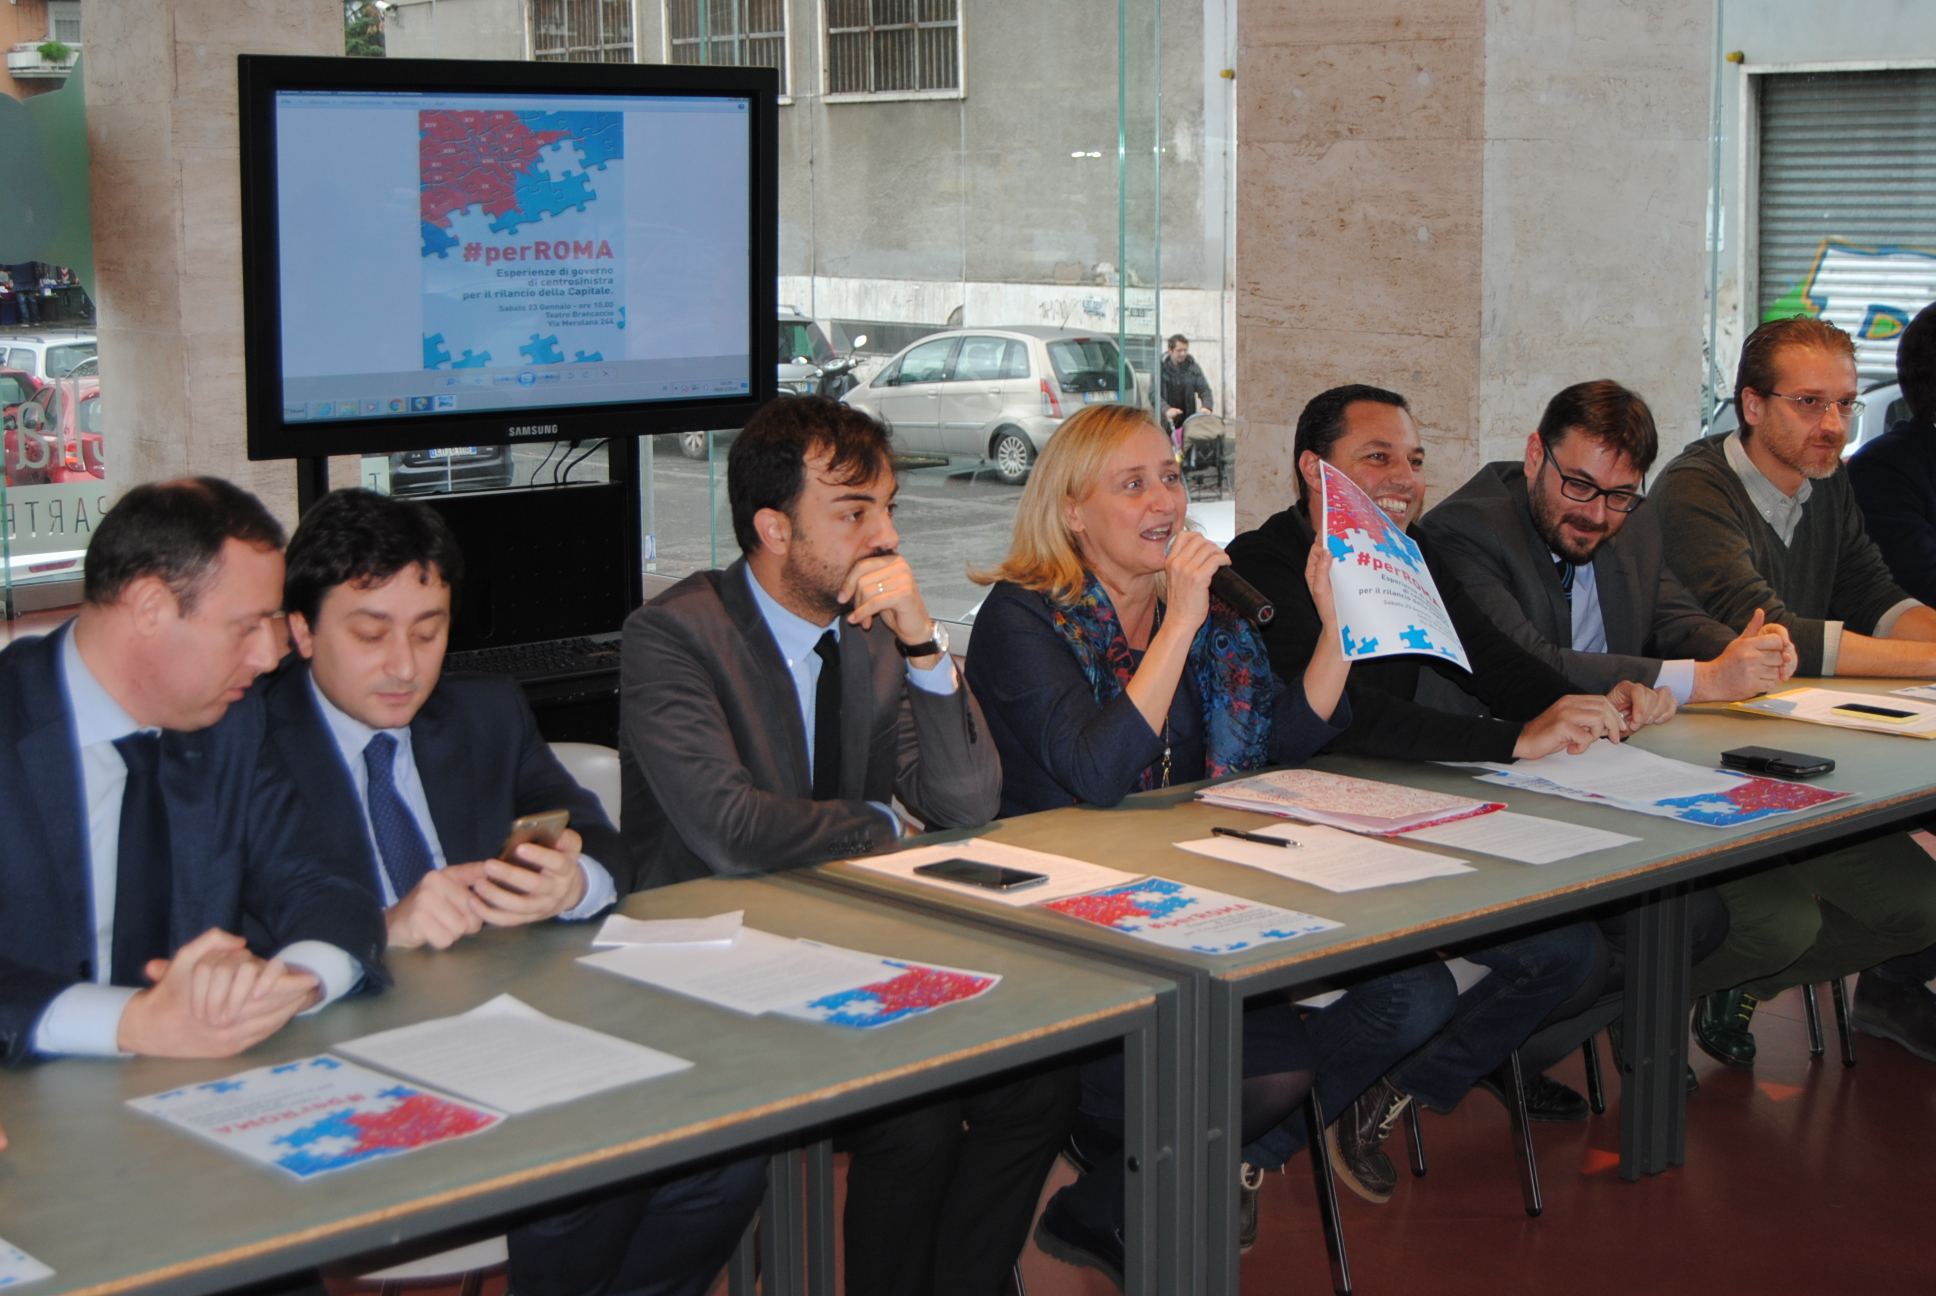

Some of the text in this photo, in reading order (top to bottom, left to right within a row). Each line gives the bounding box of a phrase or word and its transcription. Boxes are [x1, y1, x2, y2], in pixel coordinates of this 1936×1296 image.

[463, 239, 615, 266] #perROMA
[496, 267, 614, 279] Esperienze di governo
[528, 277, 614, 287] di centrosinistra
[462, 286, 614, 300] per il rilancio della Capitale.
[498, 304, 527, 312] Sabato
[528, 303, 538, 311] 23
[539, 303, 572, 311] Gennaio
[593, 301, 614, 309] 10.00
[545, 310, 614, 319] Teatro Brancaccio
[561, 319, 599, 327] Merulana
[509, 424, 558, 437] SAMSUNG
[1357, 551, 1442, 611] #perROMA
[1358, 588, 1373, 596] per
[1382, 589, 1412, 601] rilancio
